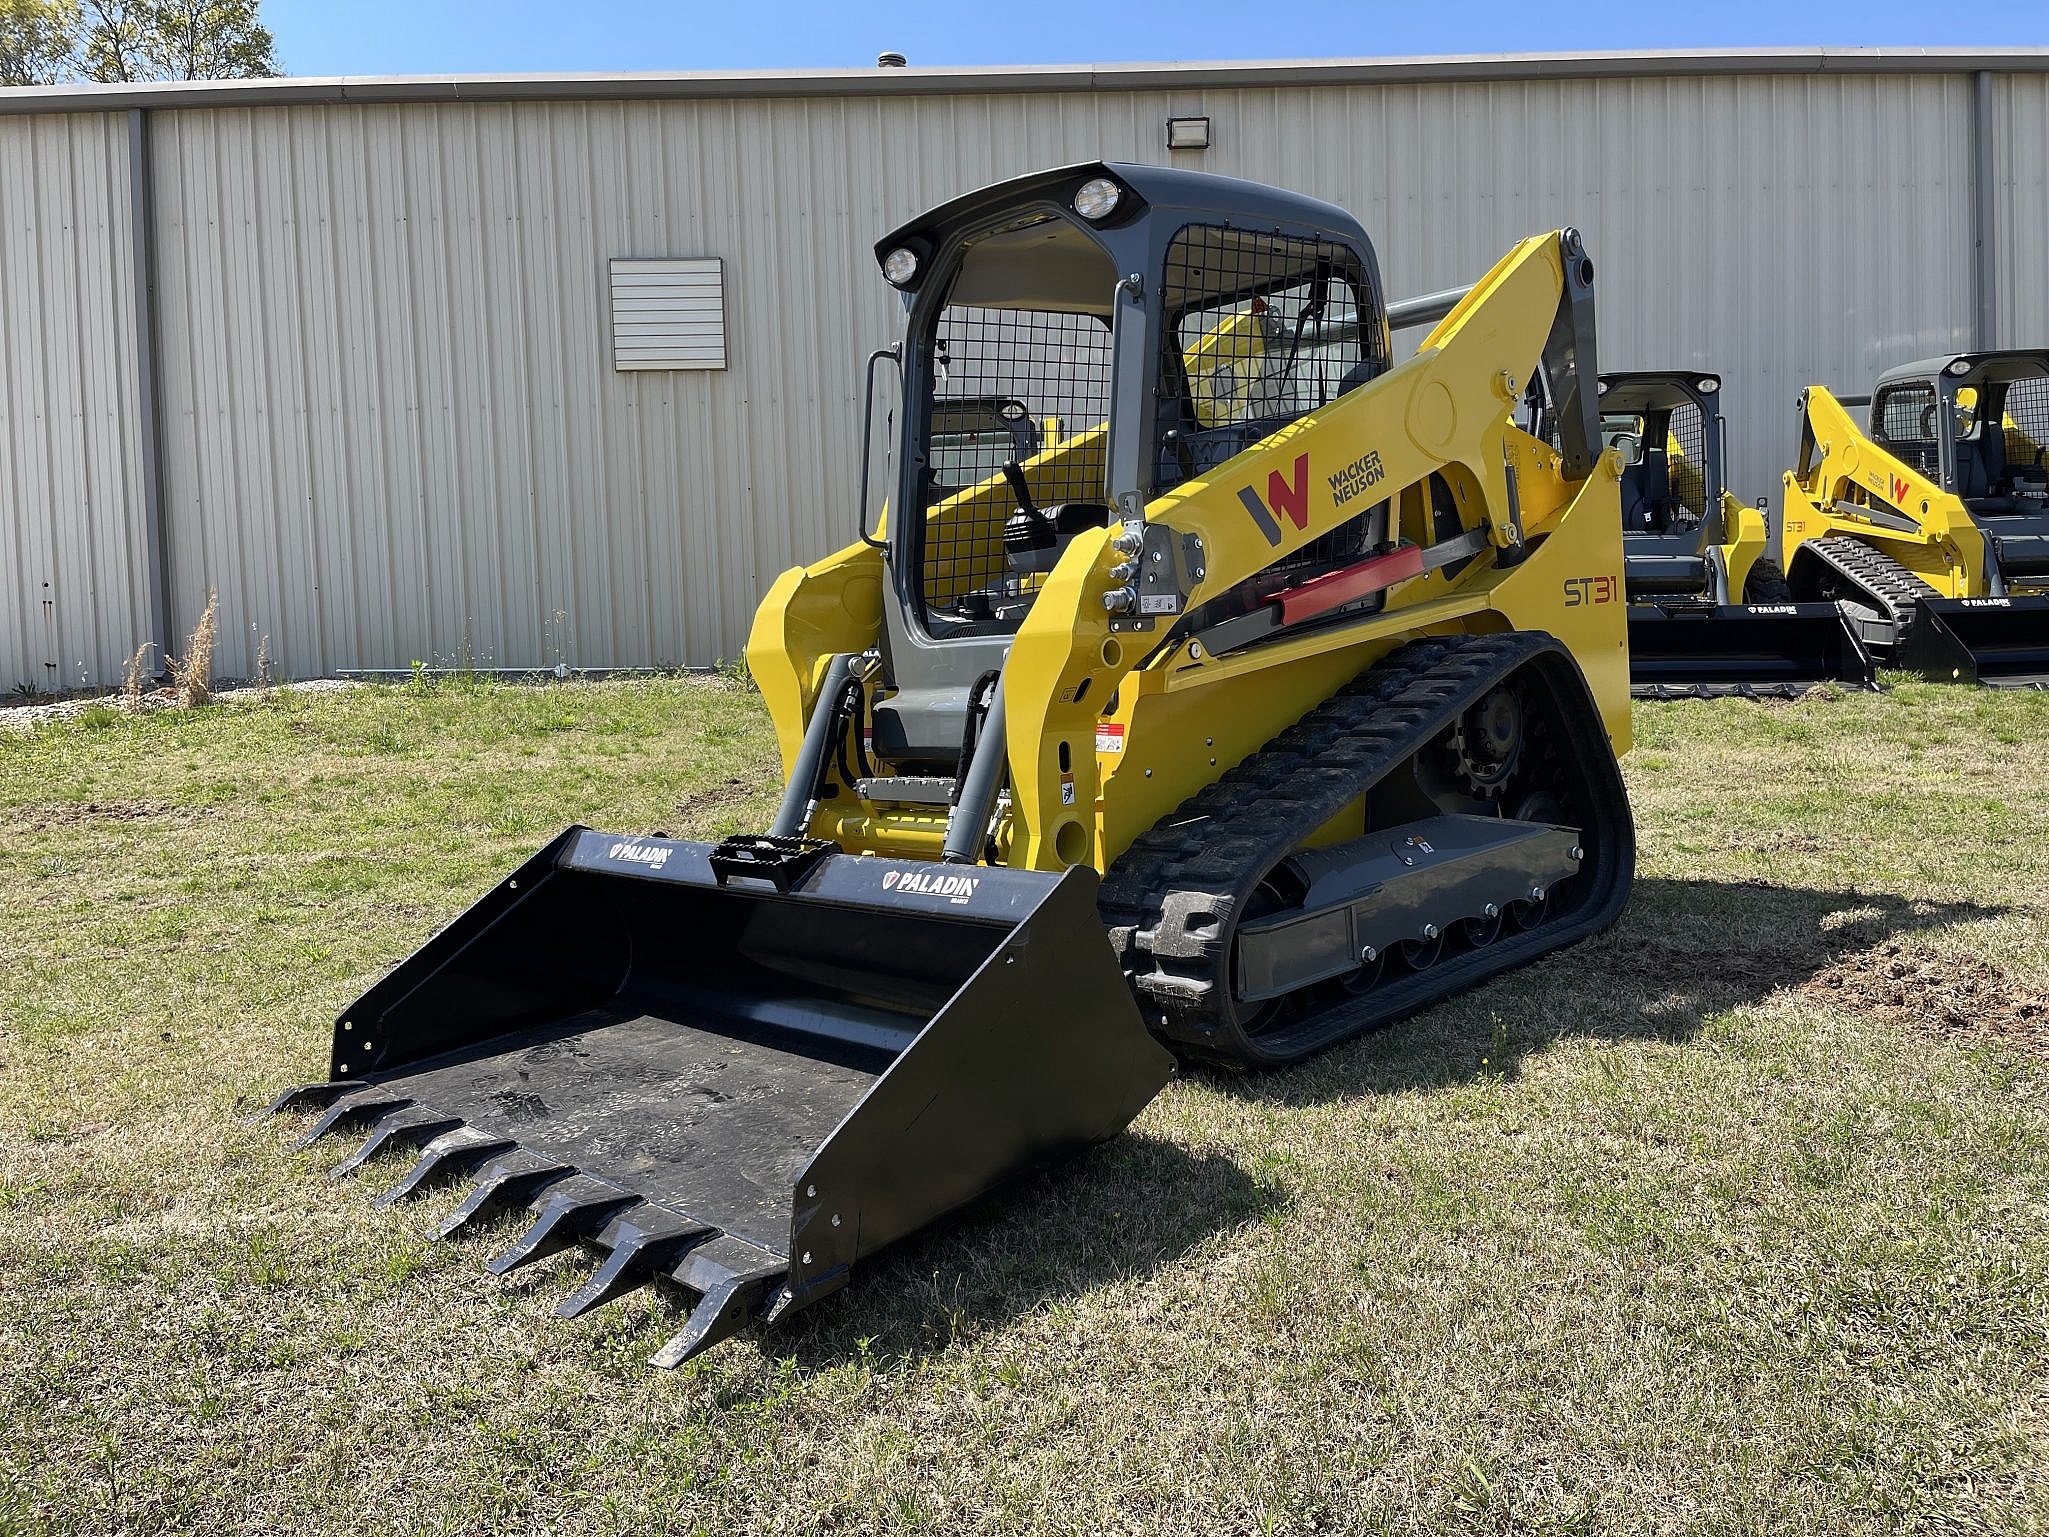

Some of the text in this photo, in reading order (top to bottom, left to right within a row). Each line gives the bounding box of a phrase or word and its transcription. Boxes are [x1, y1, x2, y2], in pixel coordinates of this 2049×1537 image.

[1328, 450, 1382, 490] WACKER
[1333, 464, 1386, 508] NEUSON
[1786, 521, 1806, 533] ST31
[1563, 576, 1617, 607] ST31
[1971, 598, 2009, 606] PALADIN
[1757, 605, 1797, 614] PALADIN
[618, 844, 674, 864] PALADIN
[896, 872, 980, 896] PALADIN
